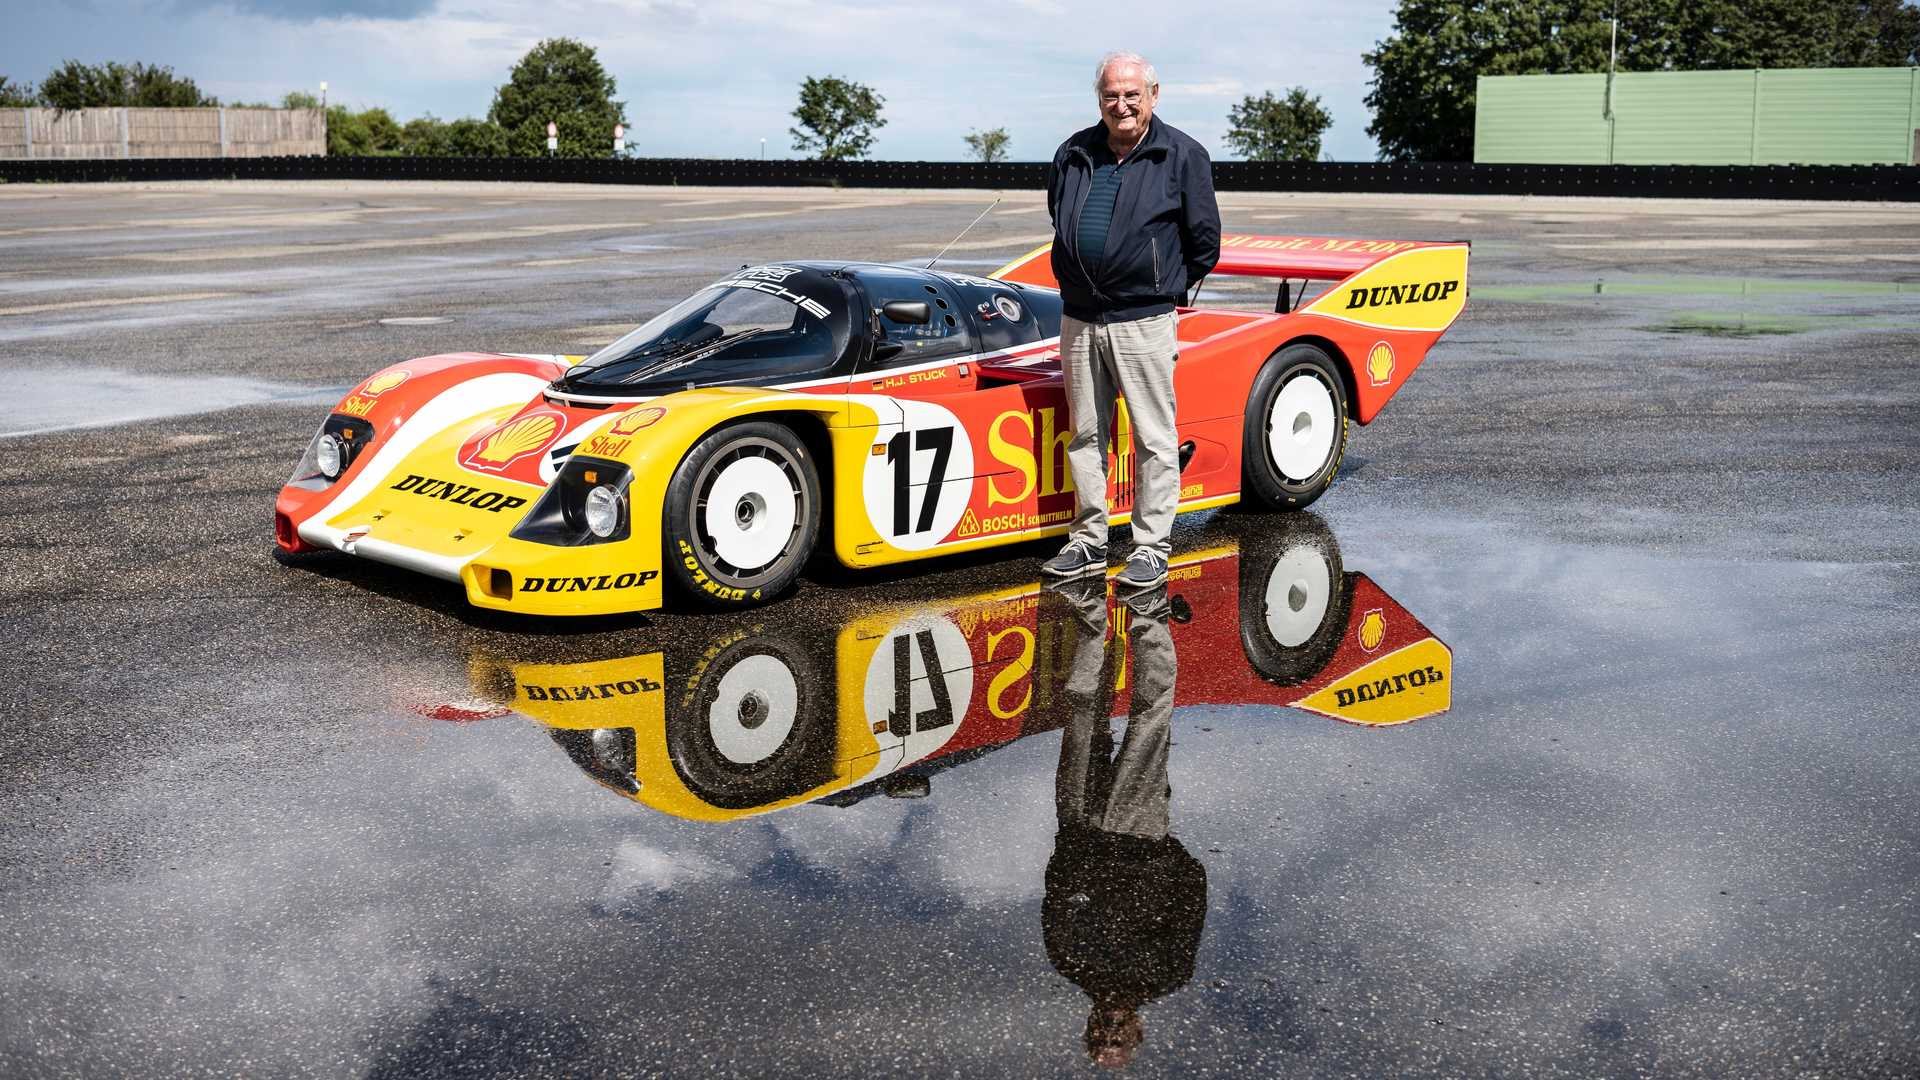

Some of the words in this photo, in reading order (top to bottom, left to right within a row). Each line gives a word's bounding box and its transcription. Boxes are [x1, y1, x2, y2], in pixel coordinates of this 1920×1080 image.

[1346, 280, 1459, 310] DUNLOP
[909, 368, 946, 384] STUCK
[339, 395, 378, 417] Shell
[583, 436, 632, 458] Shell
[887, 426, 954, 537] 17
[390, 474, 528, 513] DUNLOP
[982, 513, 1025, 534] BOSCH
[519, 570, 659, 593] DUNLOP
[678, 539, 747, 601] DUNLOP
